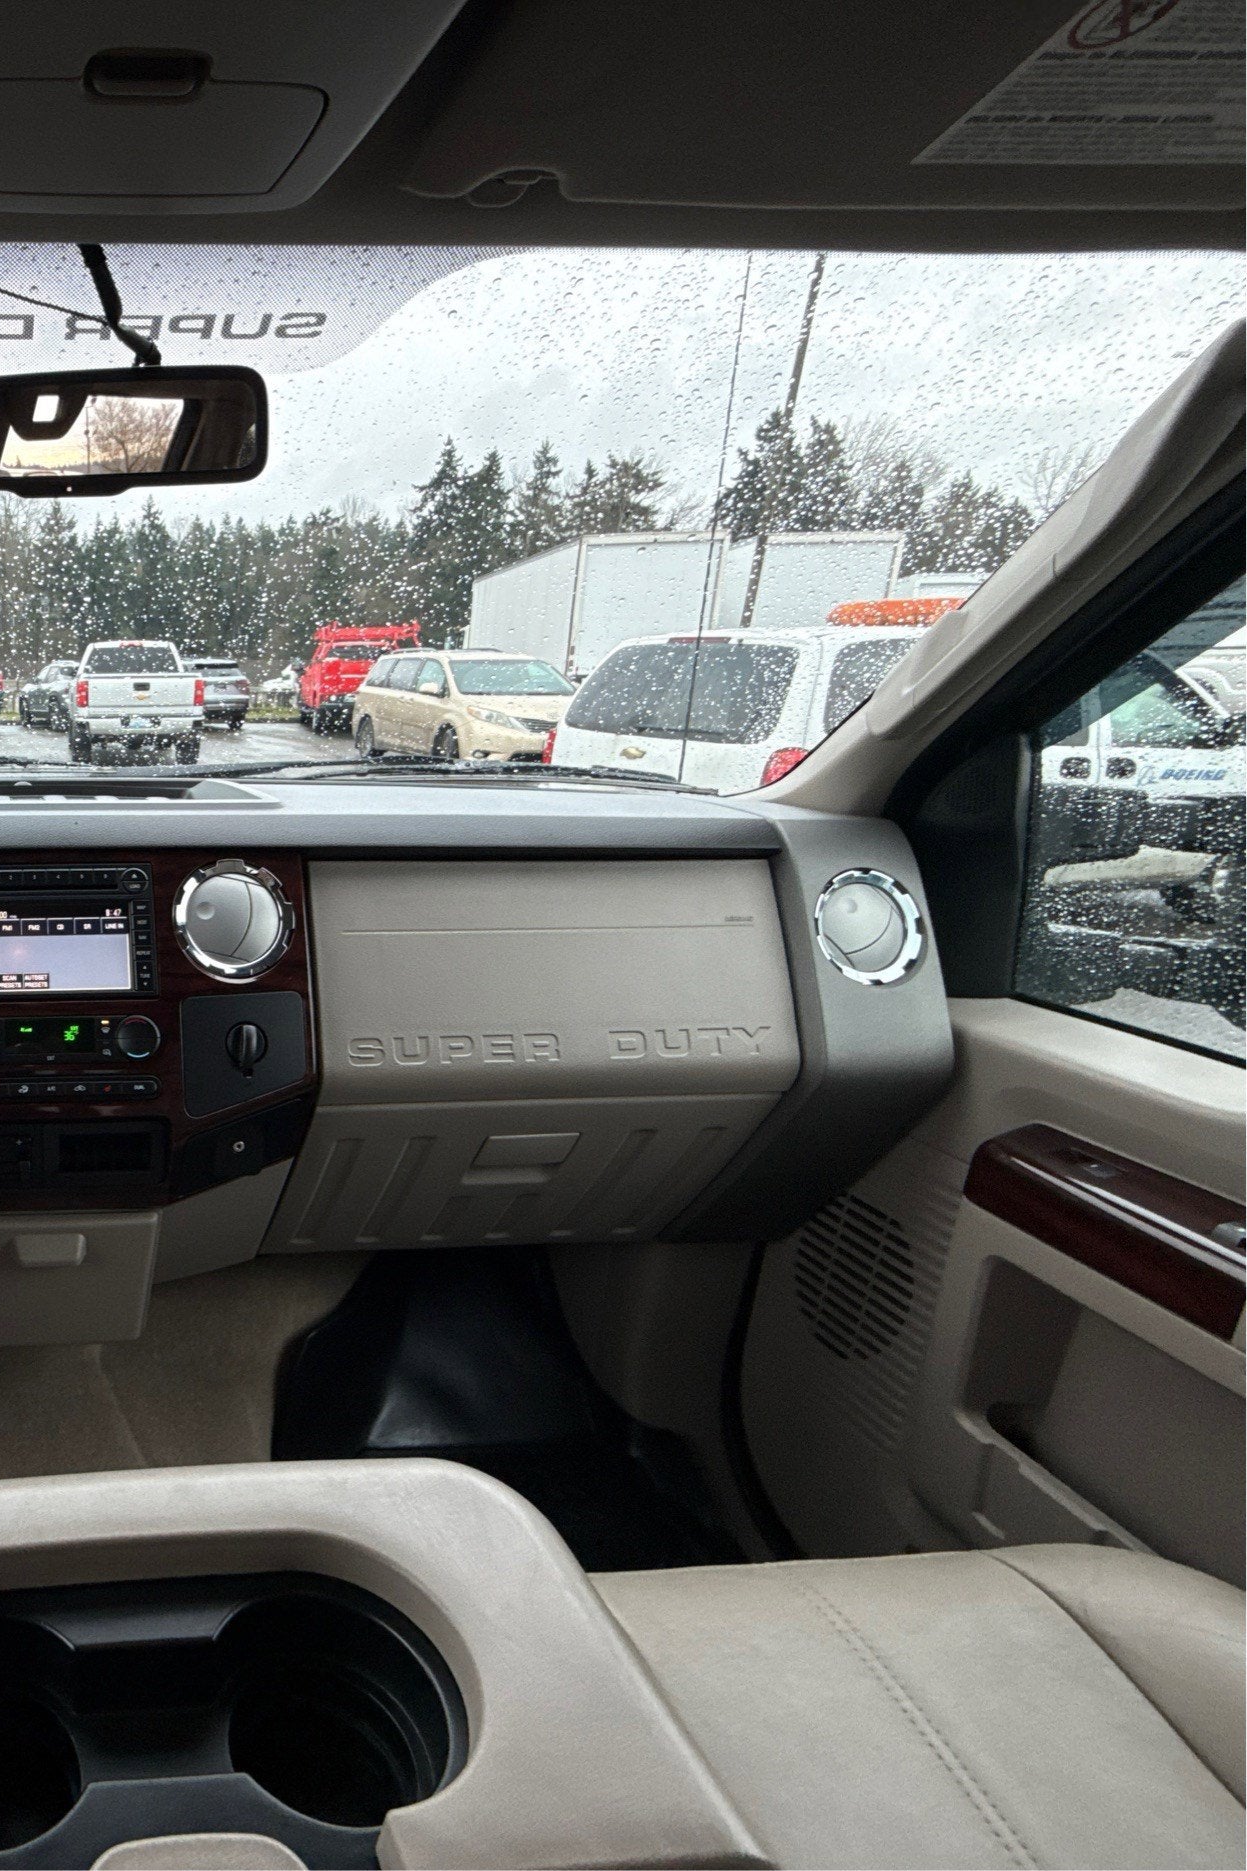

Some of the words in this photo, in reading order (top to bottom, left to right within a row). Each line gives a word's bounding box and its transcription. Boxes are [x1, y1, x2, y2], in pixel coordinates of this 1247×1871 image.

[1160, 768, 1228, 782] BOEING
[24, 981, 49, 989] PRESETS
[346, 1031, 561, 1067] SUPER
[607, 1025, 773, 1061] DUTY
